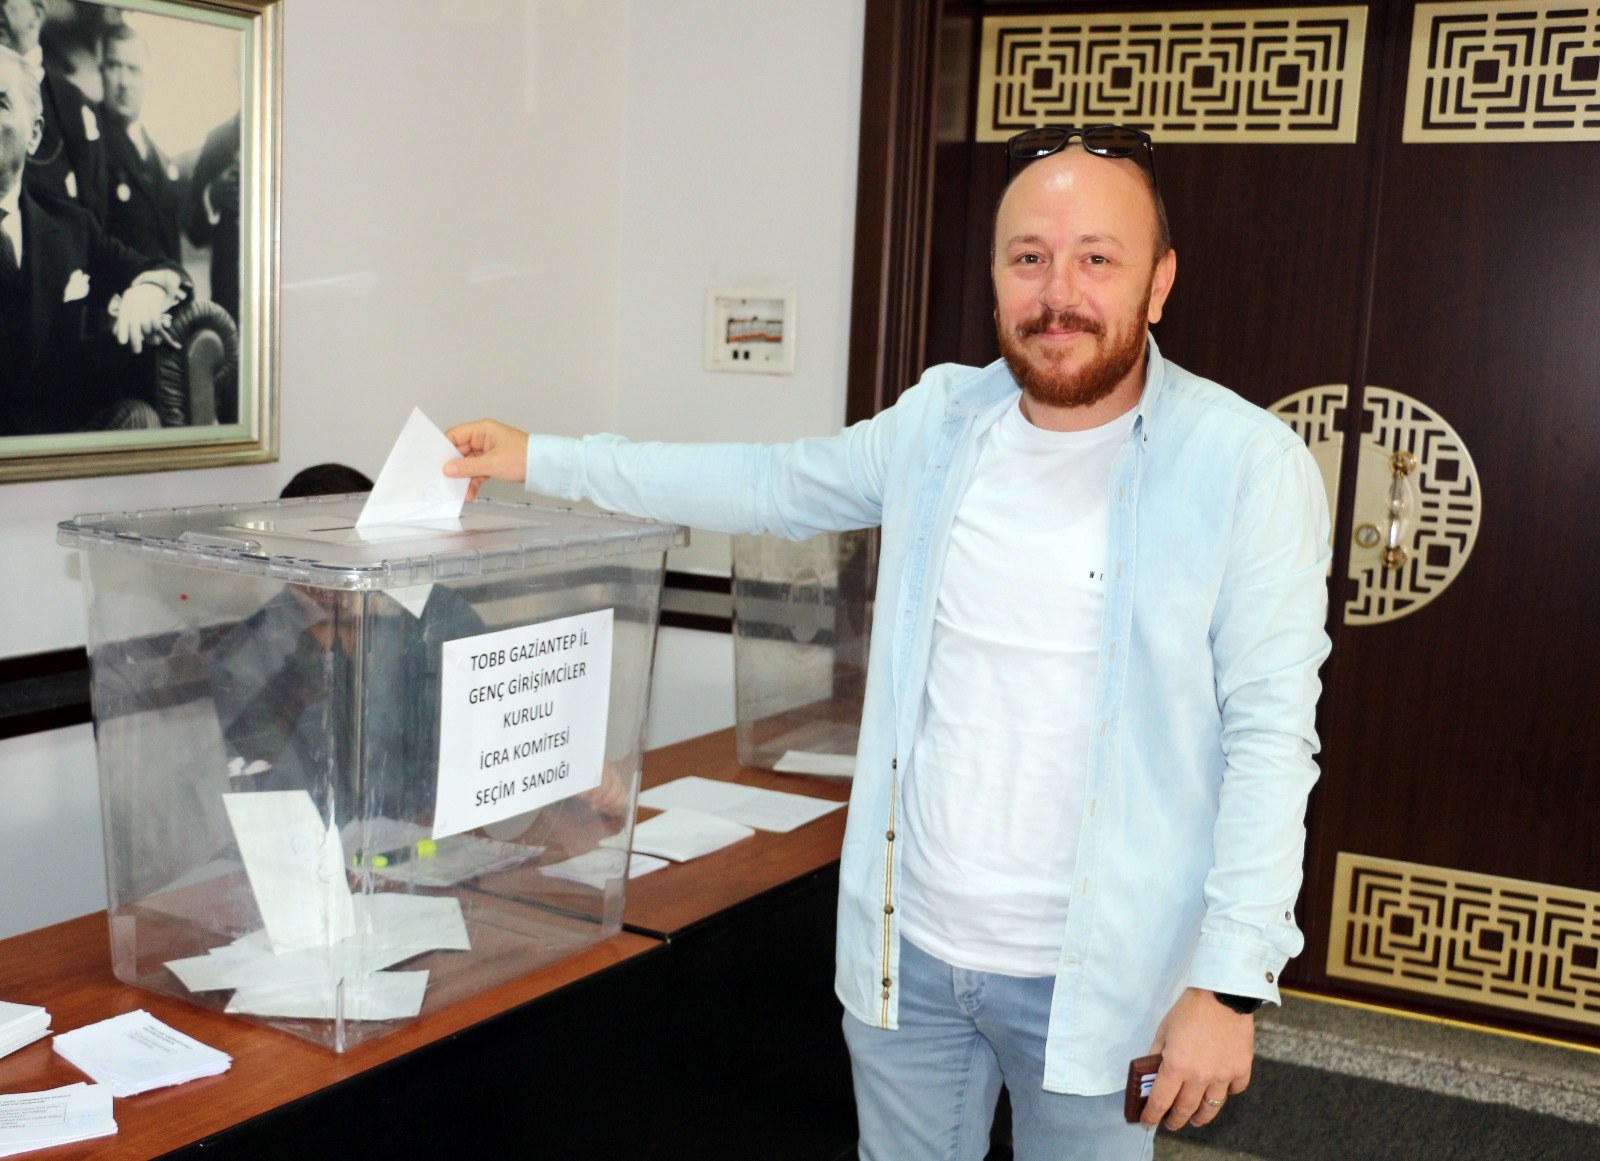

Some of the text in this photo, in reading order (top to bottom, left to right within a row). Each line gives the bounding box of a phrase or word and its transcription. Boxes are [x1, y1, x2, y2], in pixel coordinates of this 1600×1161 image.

[470, 628, 589, 672] TOBB GAZİANTEP İL
[469, 662, 586, 704] GENÇ GİRİŞİMCİLER
[503, 701, 554, 728] KURULU
[480, 726, 570, 770] İCRA KOMİTESİ
[475, 761, 570, 807] SEÇİM SANDIĞI
